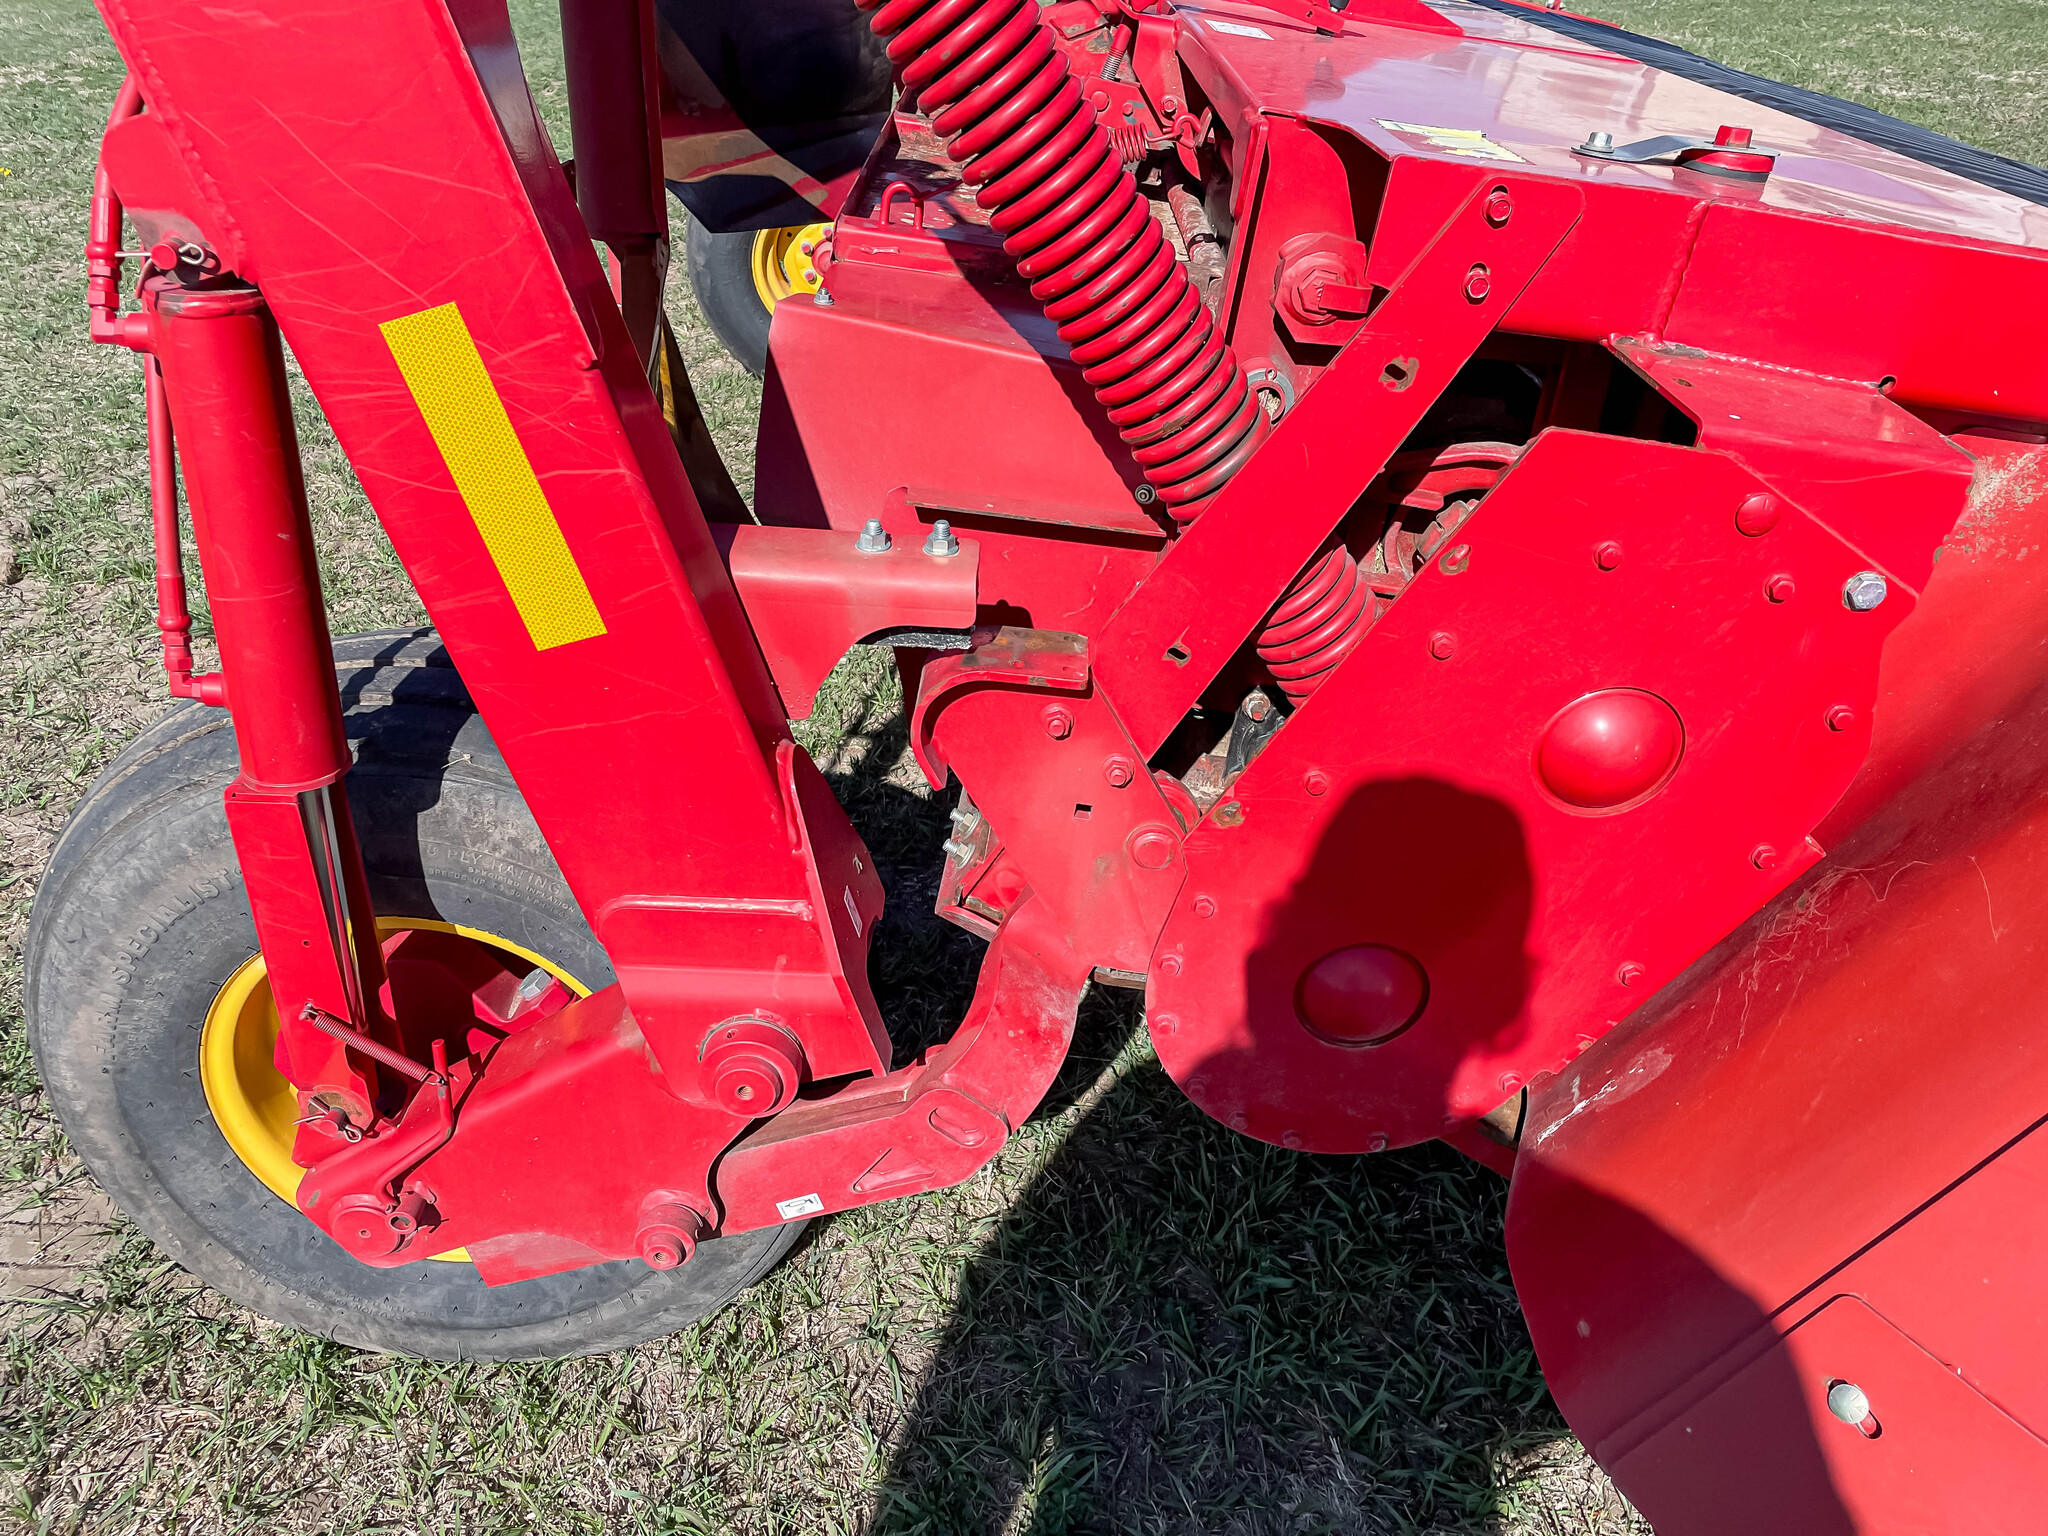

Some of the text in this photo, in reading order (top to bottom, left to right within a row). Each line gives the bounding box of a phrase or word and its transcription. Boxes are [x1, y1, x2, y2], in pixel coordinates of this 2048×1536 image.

[427, 867, 468, 881] SPEEDS
[472, 875, 486, 885] UP
[447, 850, 483, 865] PLY
[491, 859, 562, 896] RATING
[526, 884, 576, 914] INFLATION
[111, 868, 235, 986] SPECIALIST
